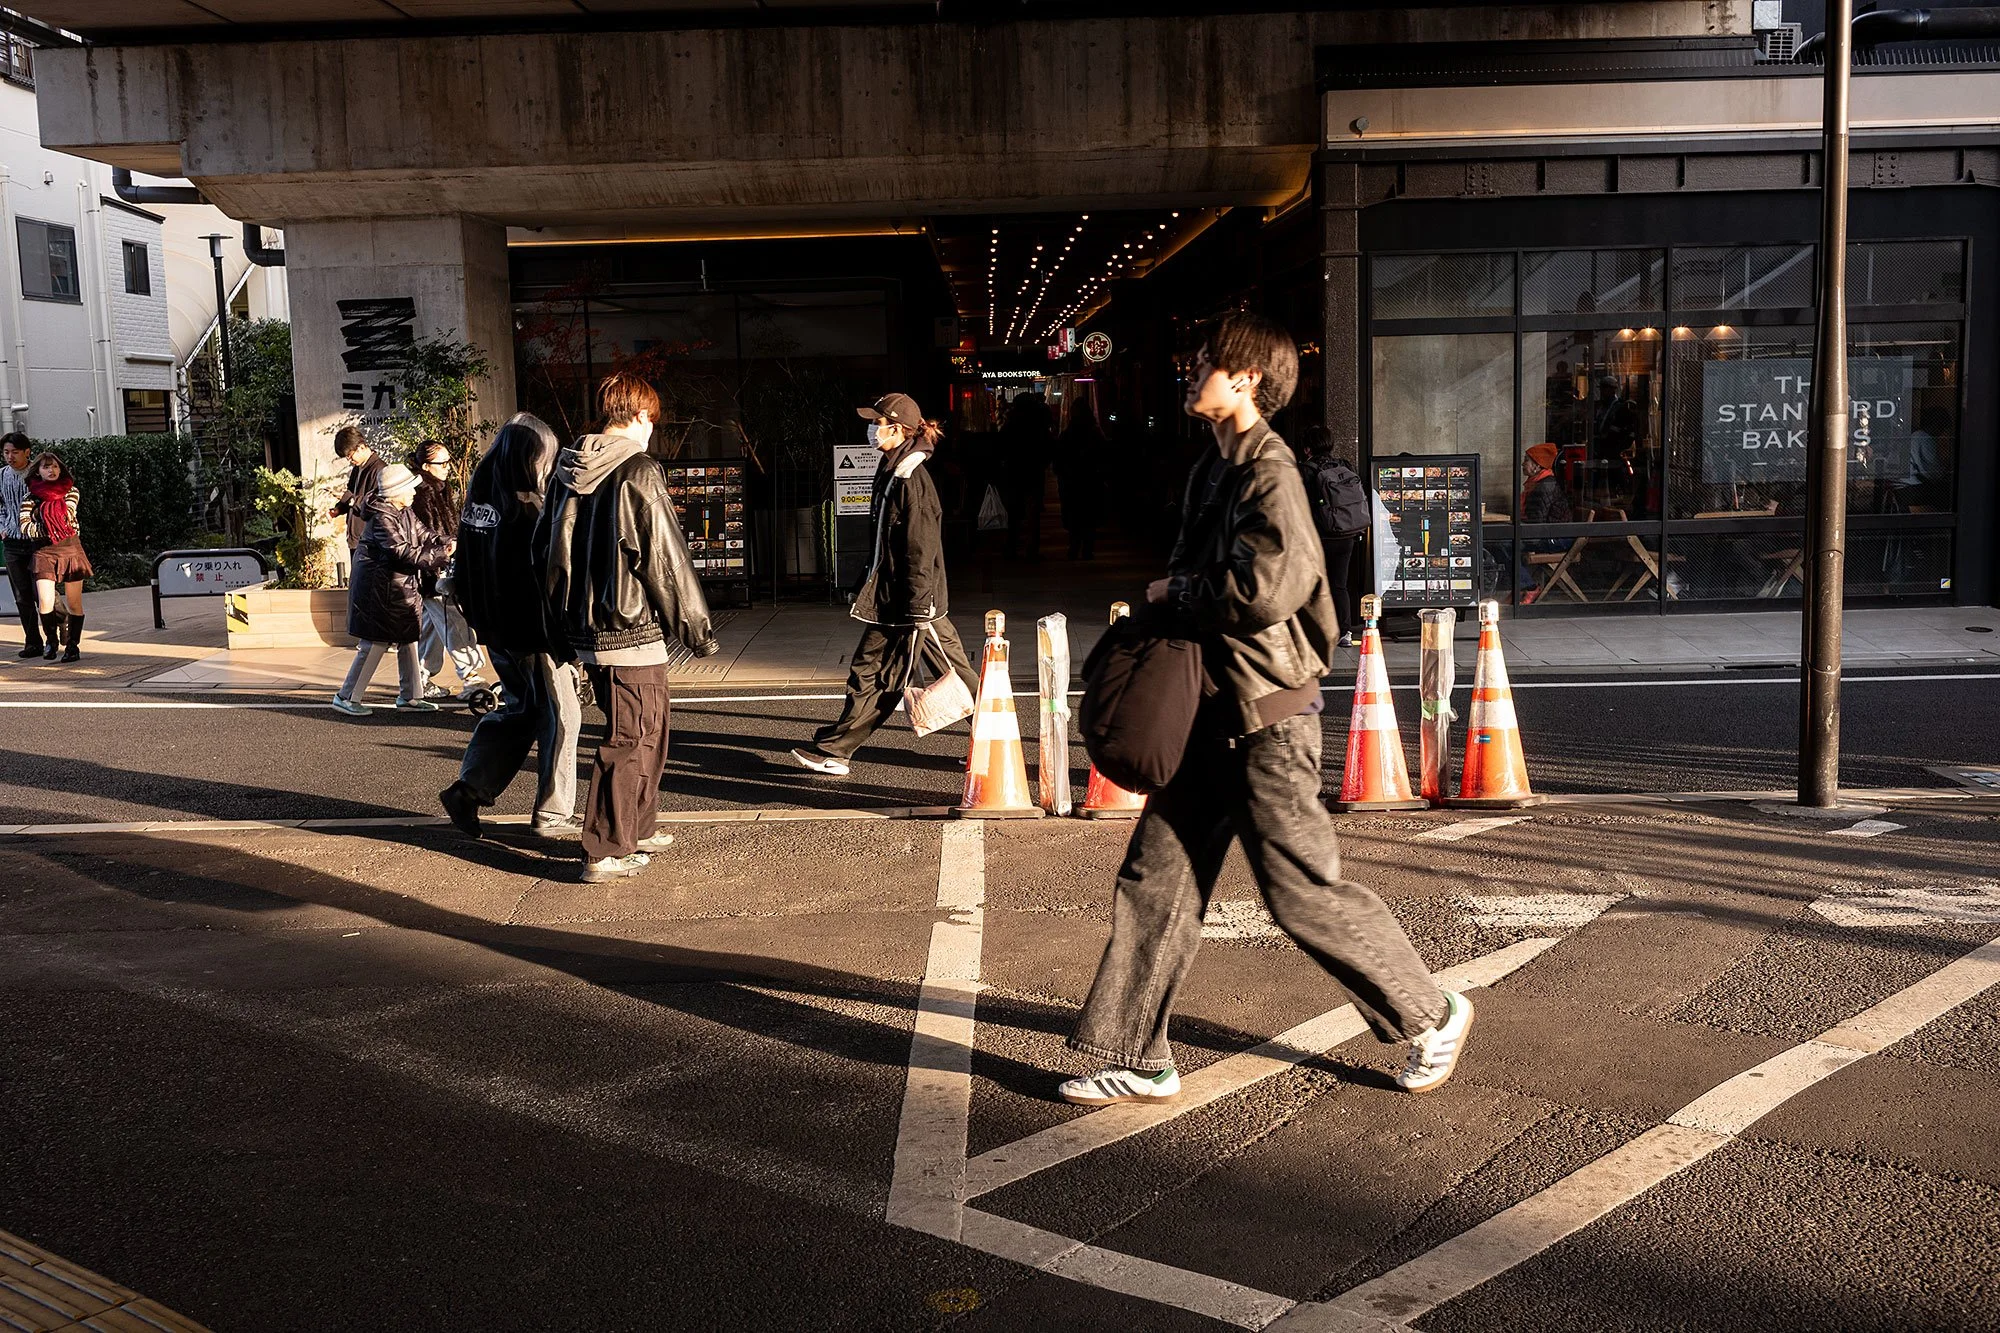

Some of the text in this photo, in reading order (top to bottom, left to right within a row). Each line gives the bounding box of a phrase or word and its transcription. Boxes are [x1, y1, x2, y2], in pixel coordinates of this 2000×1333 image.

[997, 370, 1042, 378] BOOKSTORE
[1774, 375, 1811, 394] TH
[342, 381, 397, 410] ミカ
[1717, 399, 1897, 423] STANRD
[1742, 428, 1872, 450] BAKS
[175, 560, 242, 572] バイク乗り入れ
